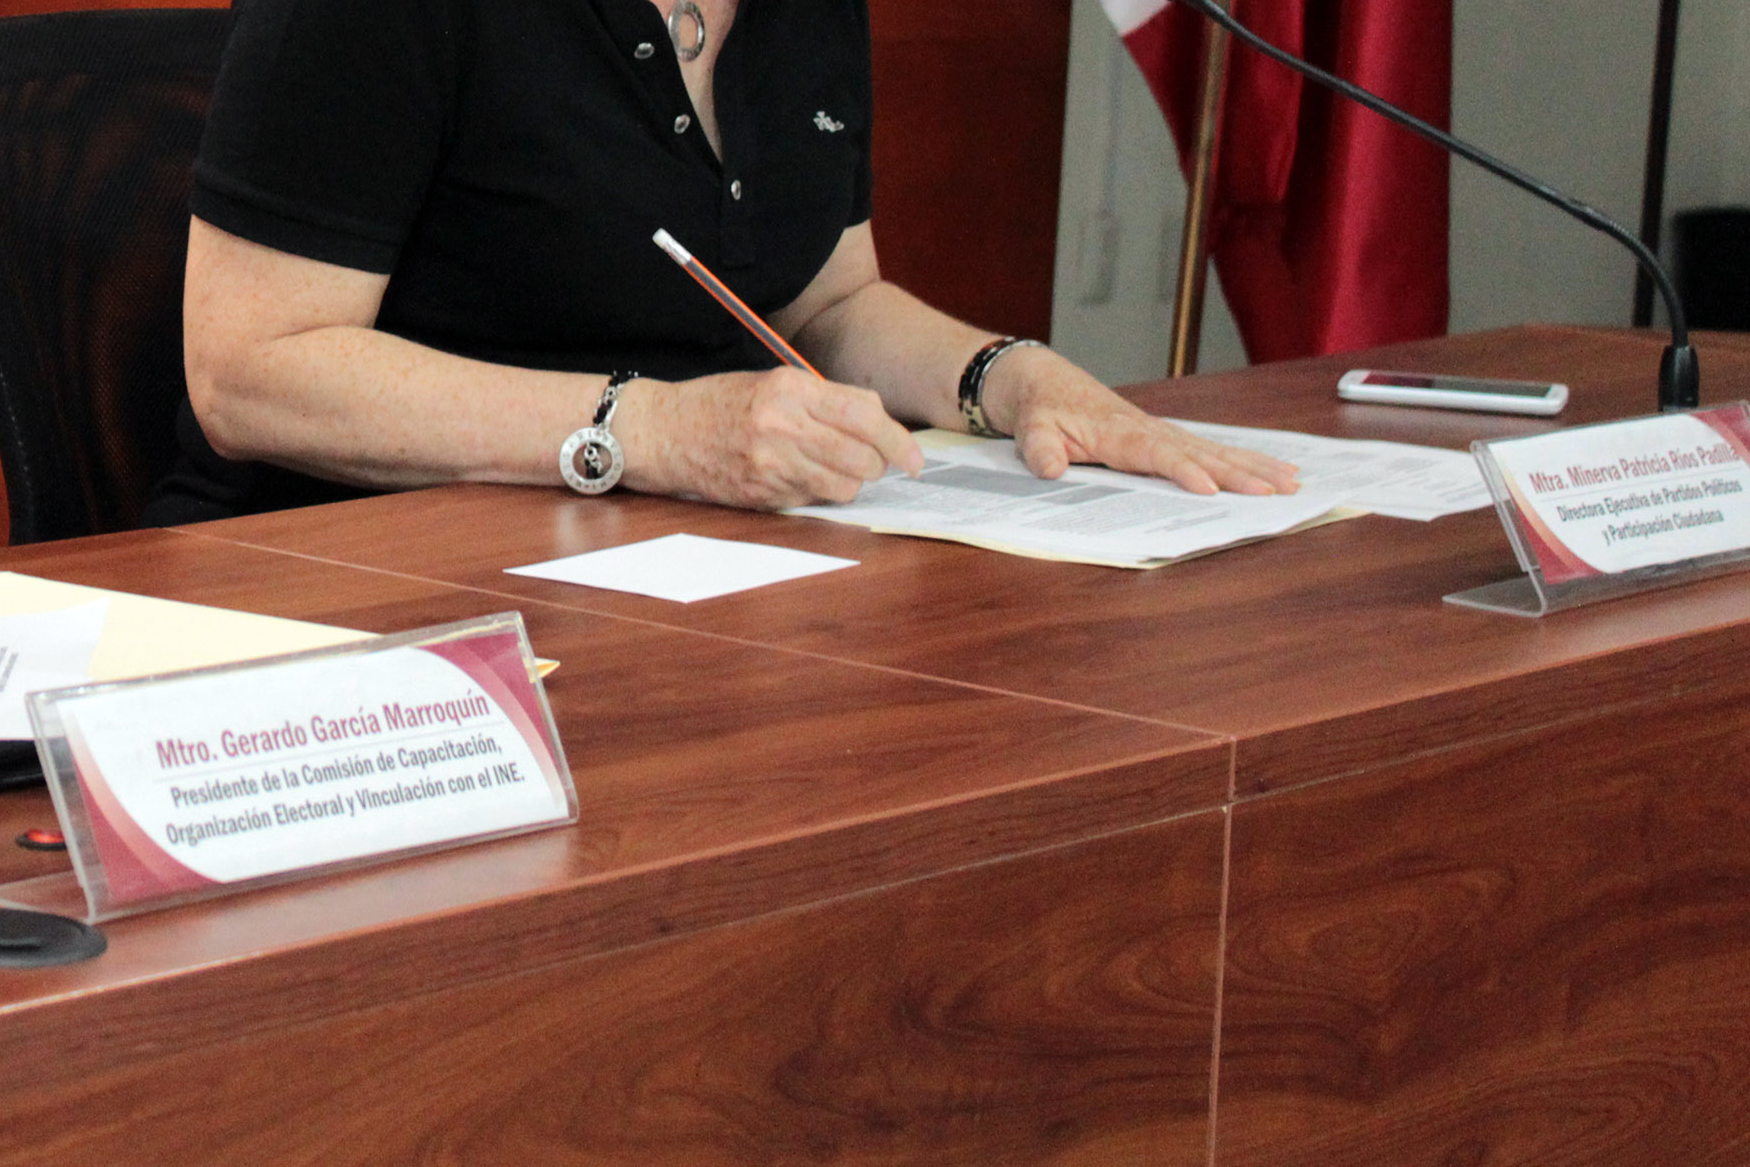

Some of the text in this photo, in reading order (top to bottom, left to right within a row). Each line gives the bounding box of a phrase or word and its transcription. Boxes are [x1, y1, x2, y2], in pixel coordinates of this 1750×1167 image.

[1529, 471, 1569, 494] Mtra.
[1567, 464, 1622, 488] Minerva
[1619, 453, 1671, 479] Patricia
[1696, 442, 1740, 466] Padilla
[1556, 501, 1606, 522] Directora
[1650, 489, 1664, 506] de
[1662, 483, 1704, 503] Partidos
[1672, 508, 1725, 530] Ciudadana
[156, 688, 491, 769] Mtro. Gerardo García Marroquín
[170, 732, 502, 809] Presidente de la Comisión de Capacitación,
[165, 762, 526, 847] Organización Electoral y Vinculación con el INE.
